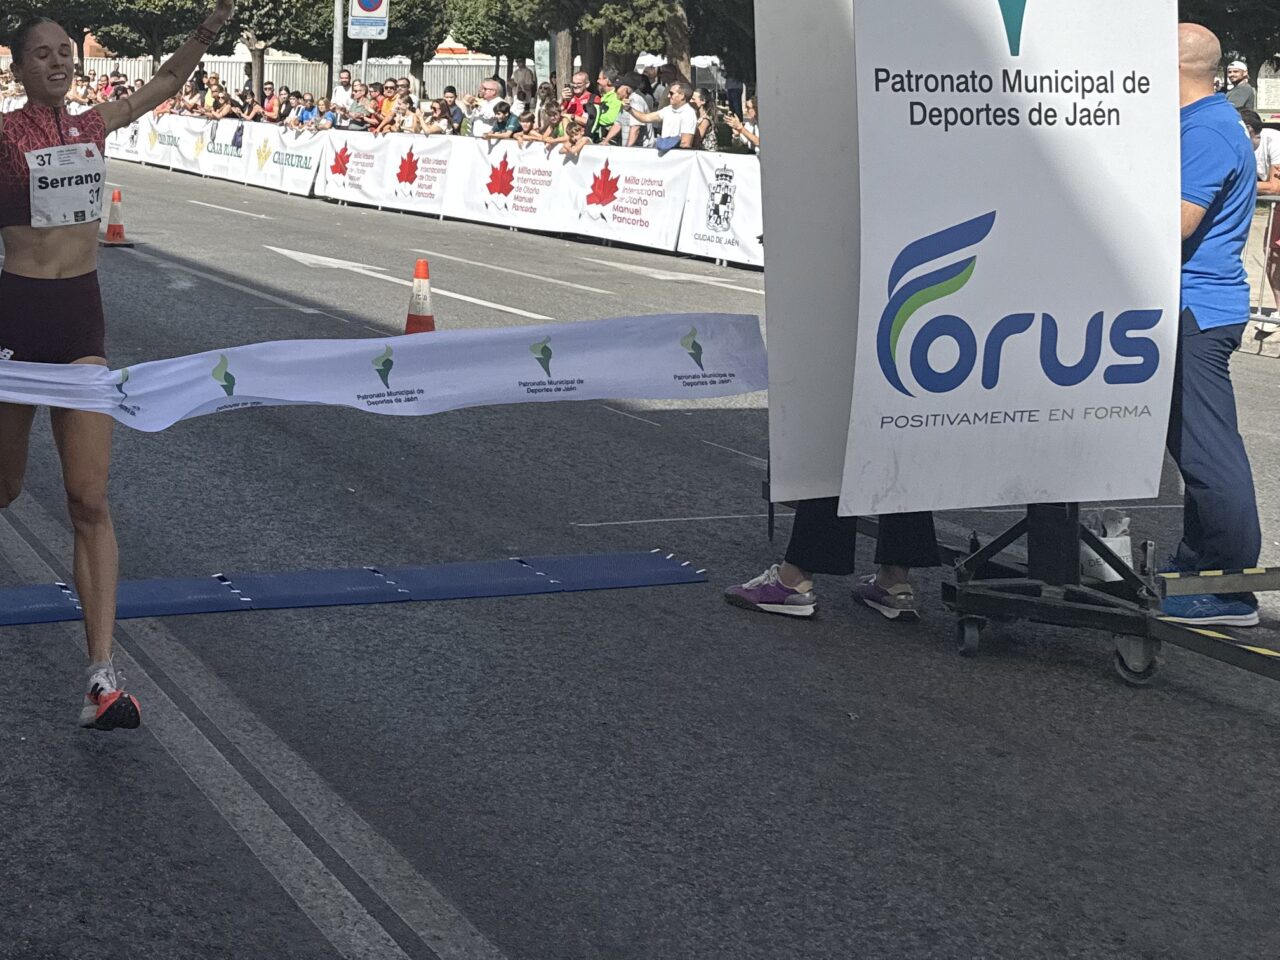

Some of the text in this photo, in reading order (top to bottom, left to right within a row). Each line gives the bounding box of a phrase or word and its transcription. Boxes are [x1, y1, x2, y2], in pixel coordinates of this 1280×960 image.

[874, 69, 1151, 99] Patronato Municipal de
[909, 100, 1120, 132] Deportes de Jaén
[36, 153, 52, 166] 37
[38, 172, 101, 189] Serrano
[612, 205, 641, 215] Manuel
[612, 214, 649, 227] Pancorbo
[880, 404, 1152, 430] POSITIVAMENTE EN FORMA
